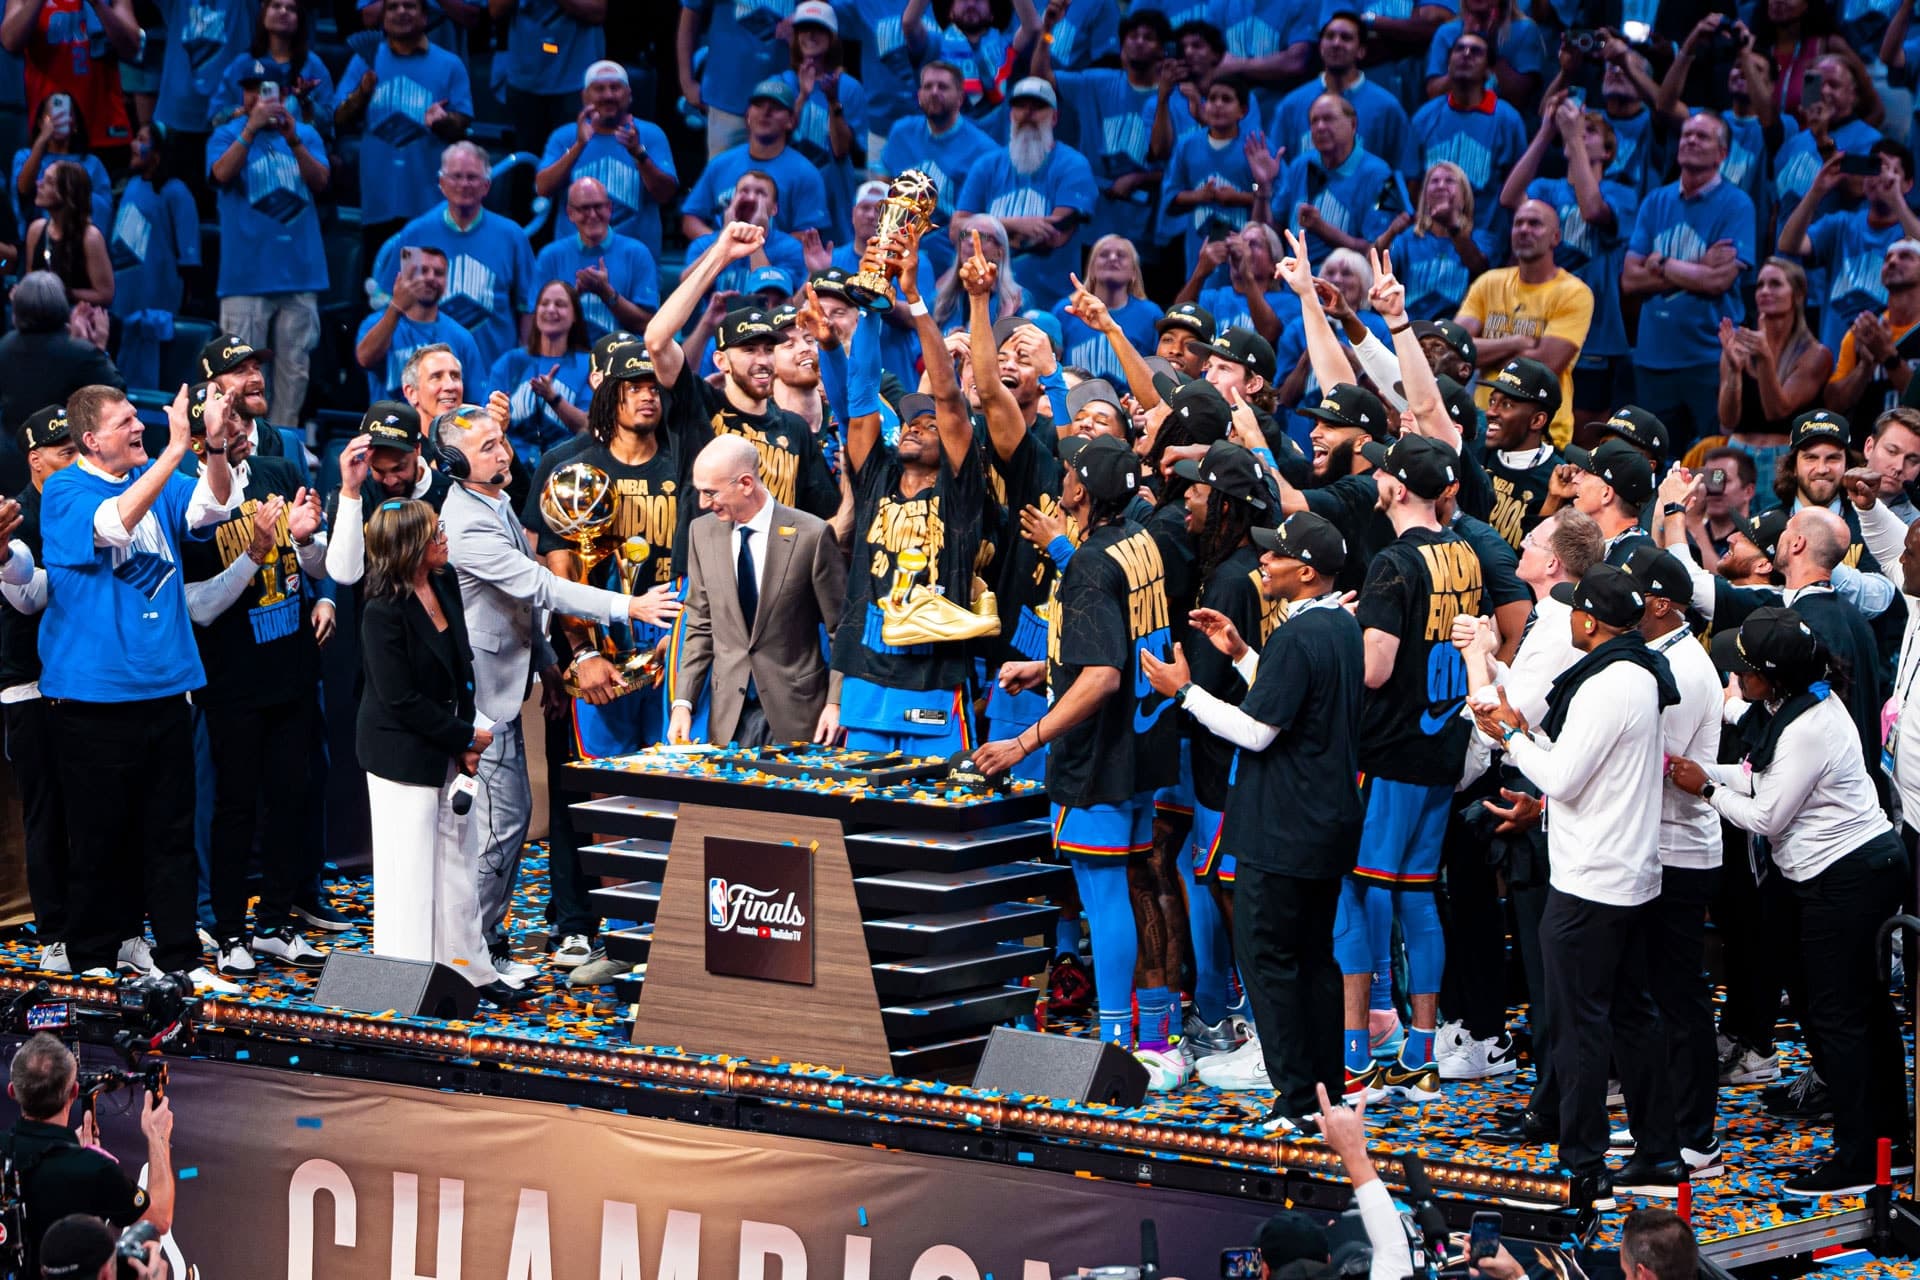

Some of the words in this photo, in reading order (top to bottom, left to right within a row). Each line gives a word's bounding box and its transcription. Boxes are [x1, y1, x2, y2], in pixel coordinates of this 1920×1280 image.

[617, 479, 649, 496] NBA
[282, 552, 297, 575] 25
[655, 557, 672, 582] 25
[870, 550, 889, 578] 20
[1417, 540, 1482, 593] WON
[717, 883, 806, 932] Finals
